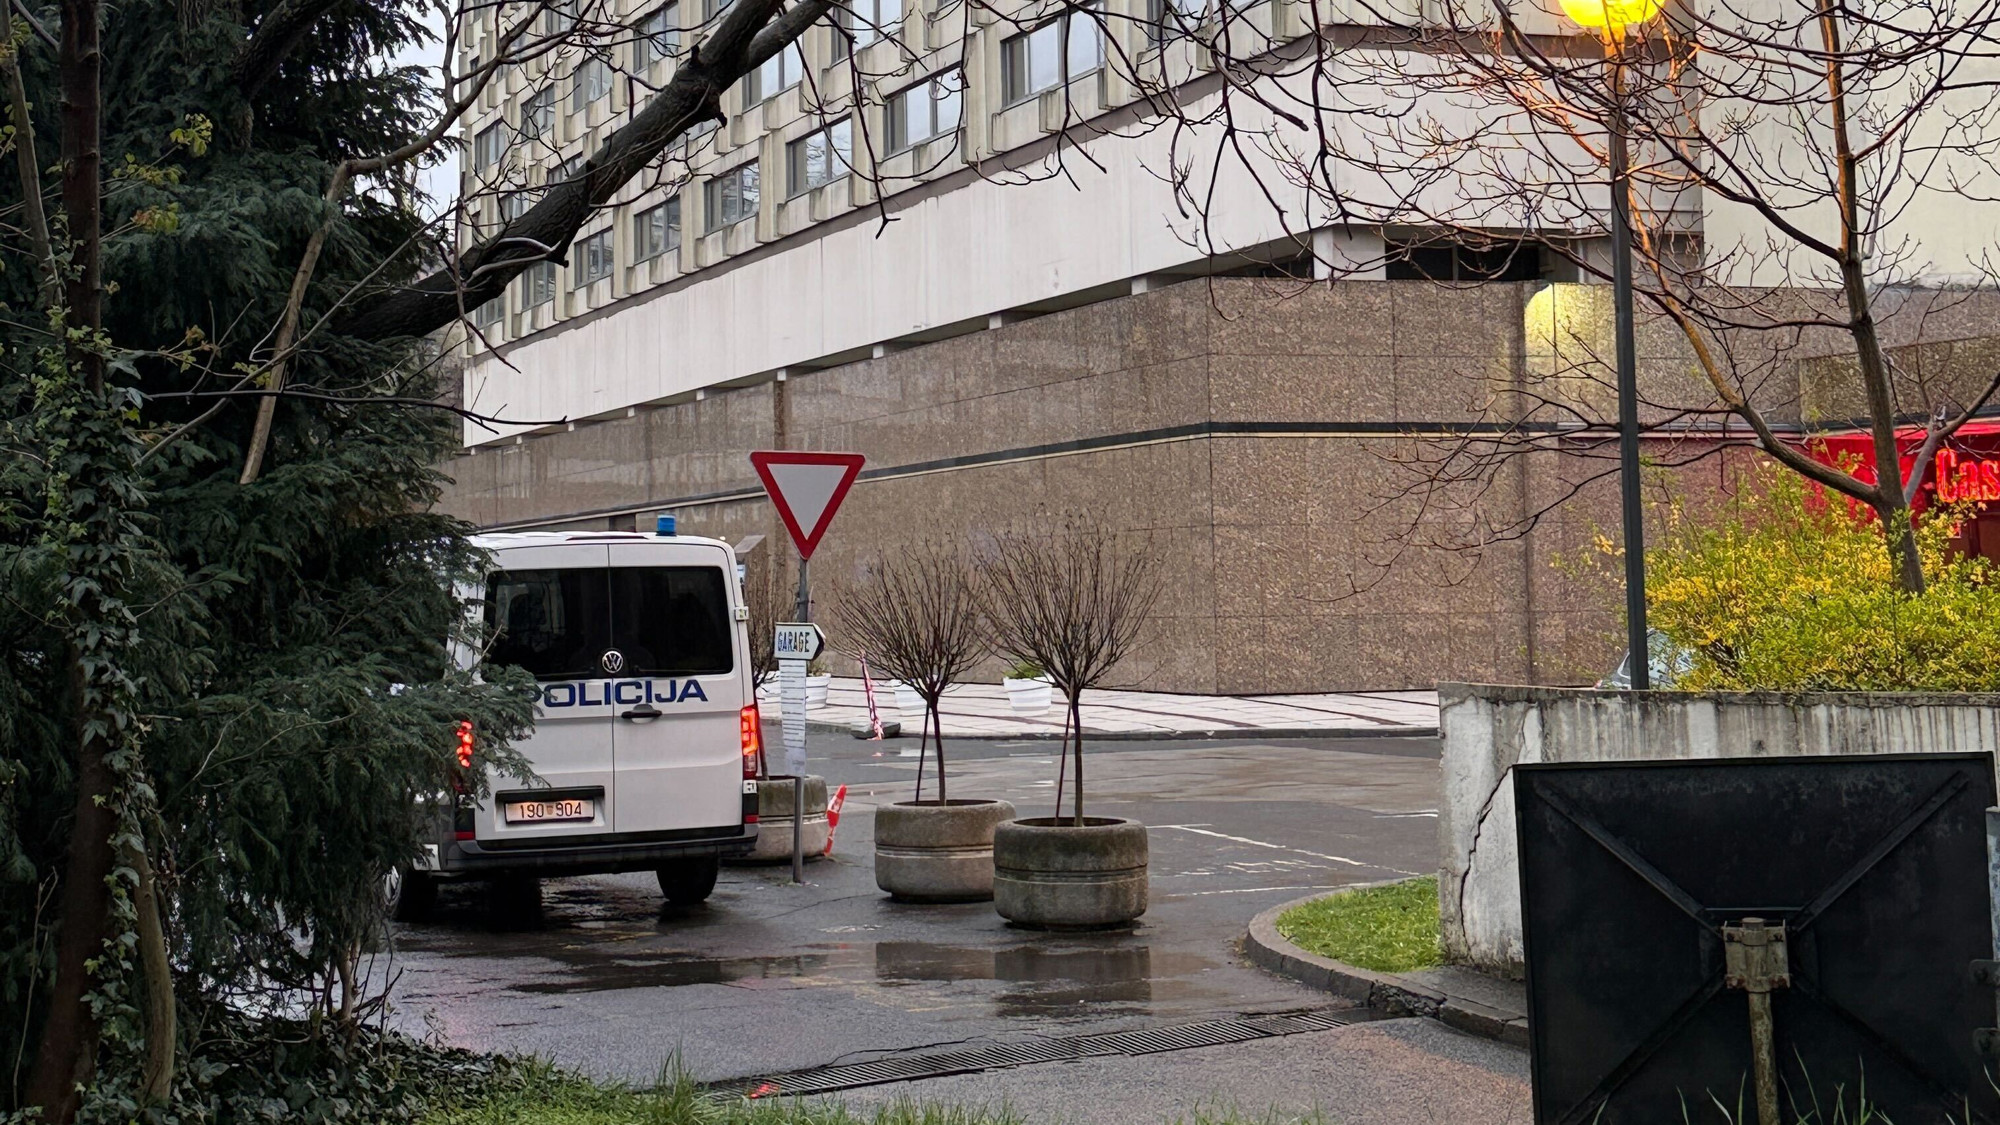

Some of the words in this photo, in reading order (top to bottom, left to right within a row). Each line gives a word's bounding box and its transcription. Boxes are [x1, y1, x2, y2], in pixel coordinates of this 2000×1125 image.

[778, 631, 810, 652] GARAGE
[520, 804, 544, 818] 190
[556, 802, 582, 816] 904
